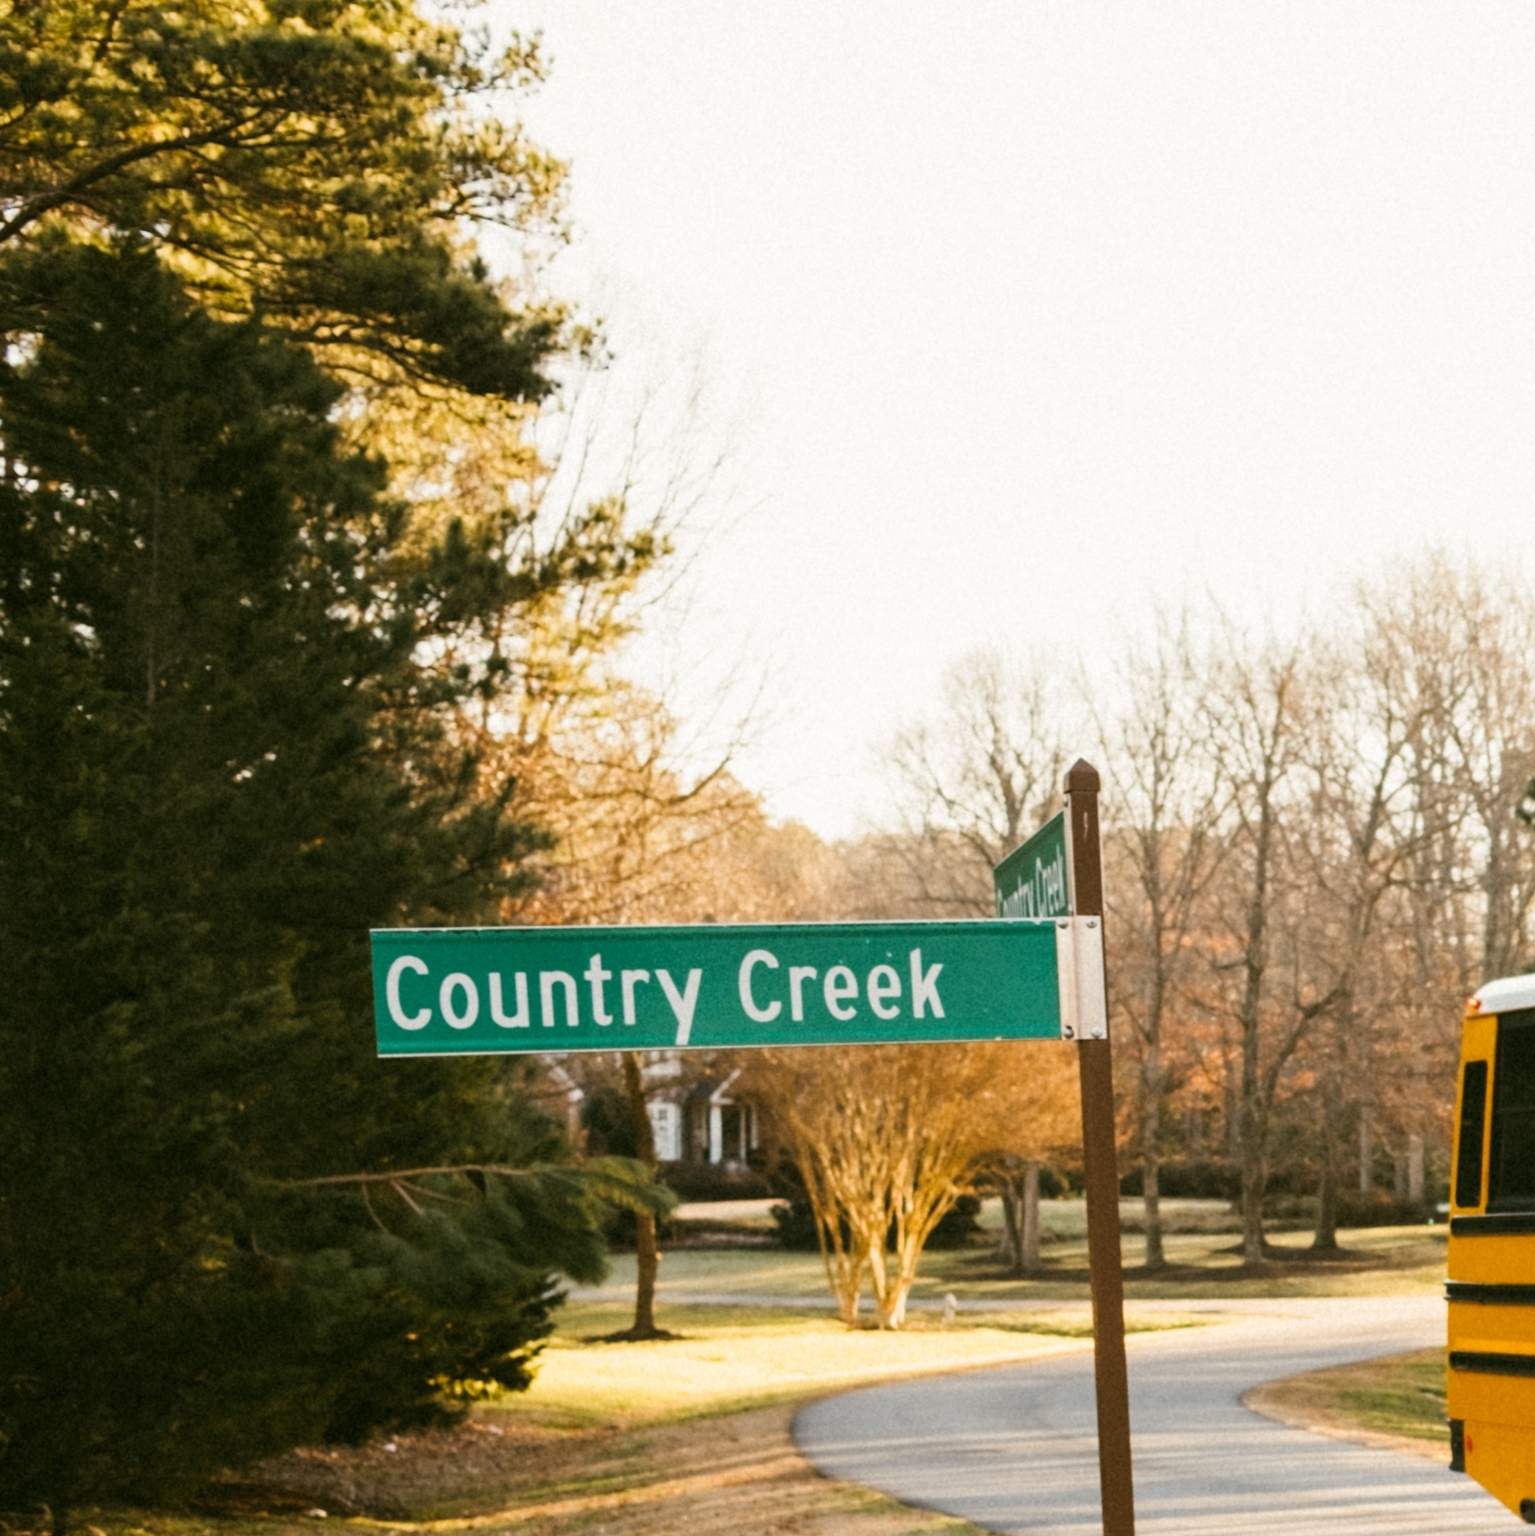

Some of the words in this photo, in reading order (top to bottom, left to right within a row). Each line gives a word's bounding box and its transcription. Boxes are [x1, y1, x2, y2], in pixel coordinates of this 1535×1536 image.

[1036, 844, 1064, 917] Creek
[386, 953, 702, 1045] Country
[738, 948, 945, 1022] Creek
